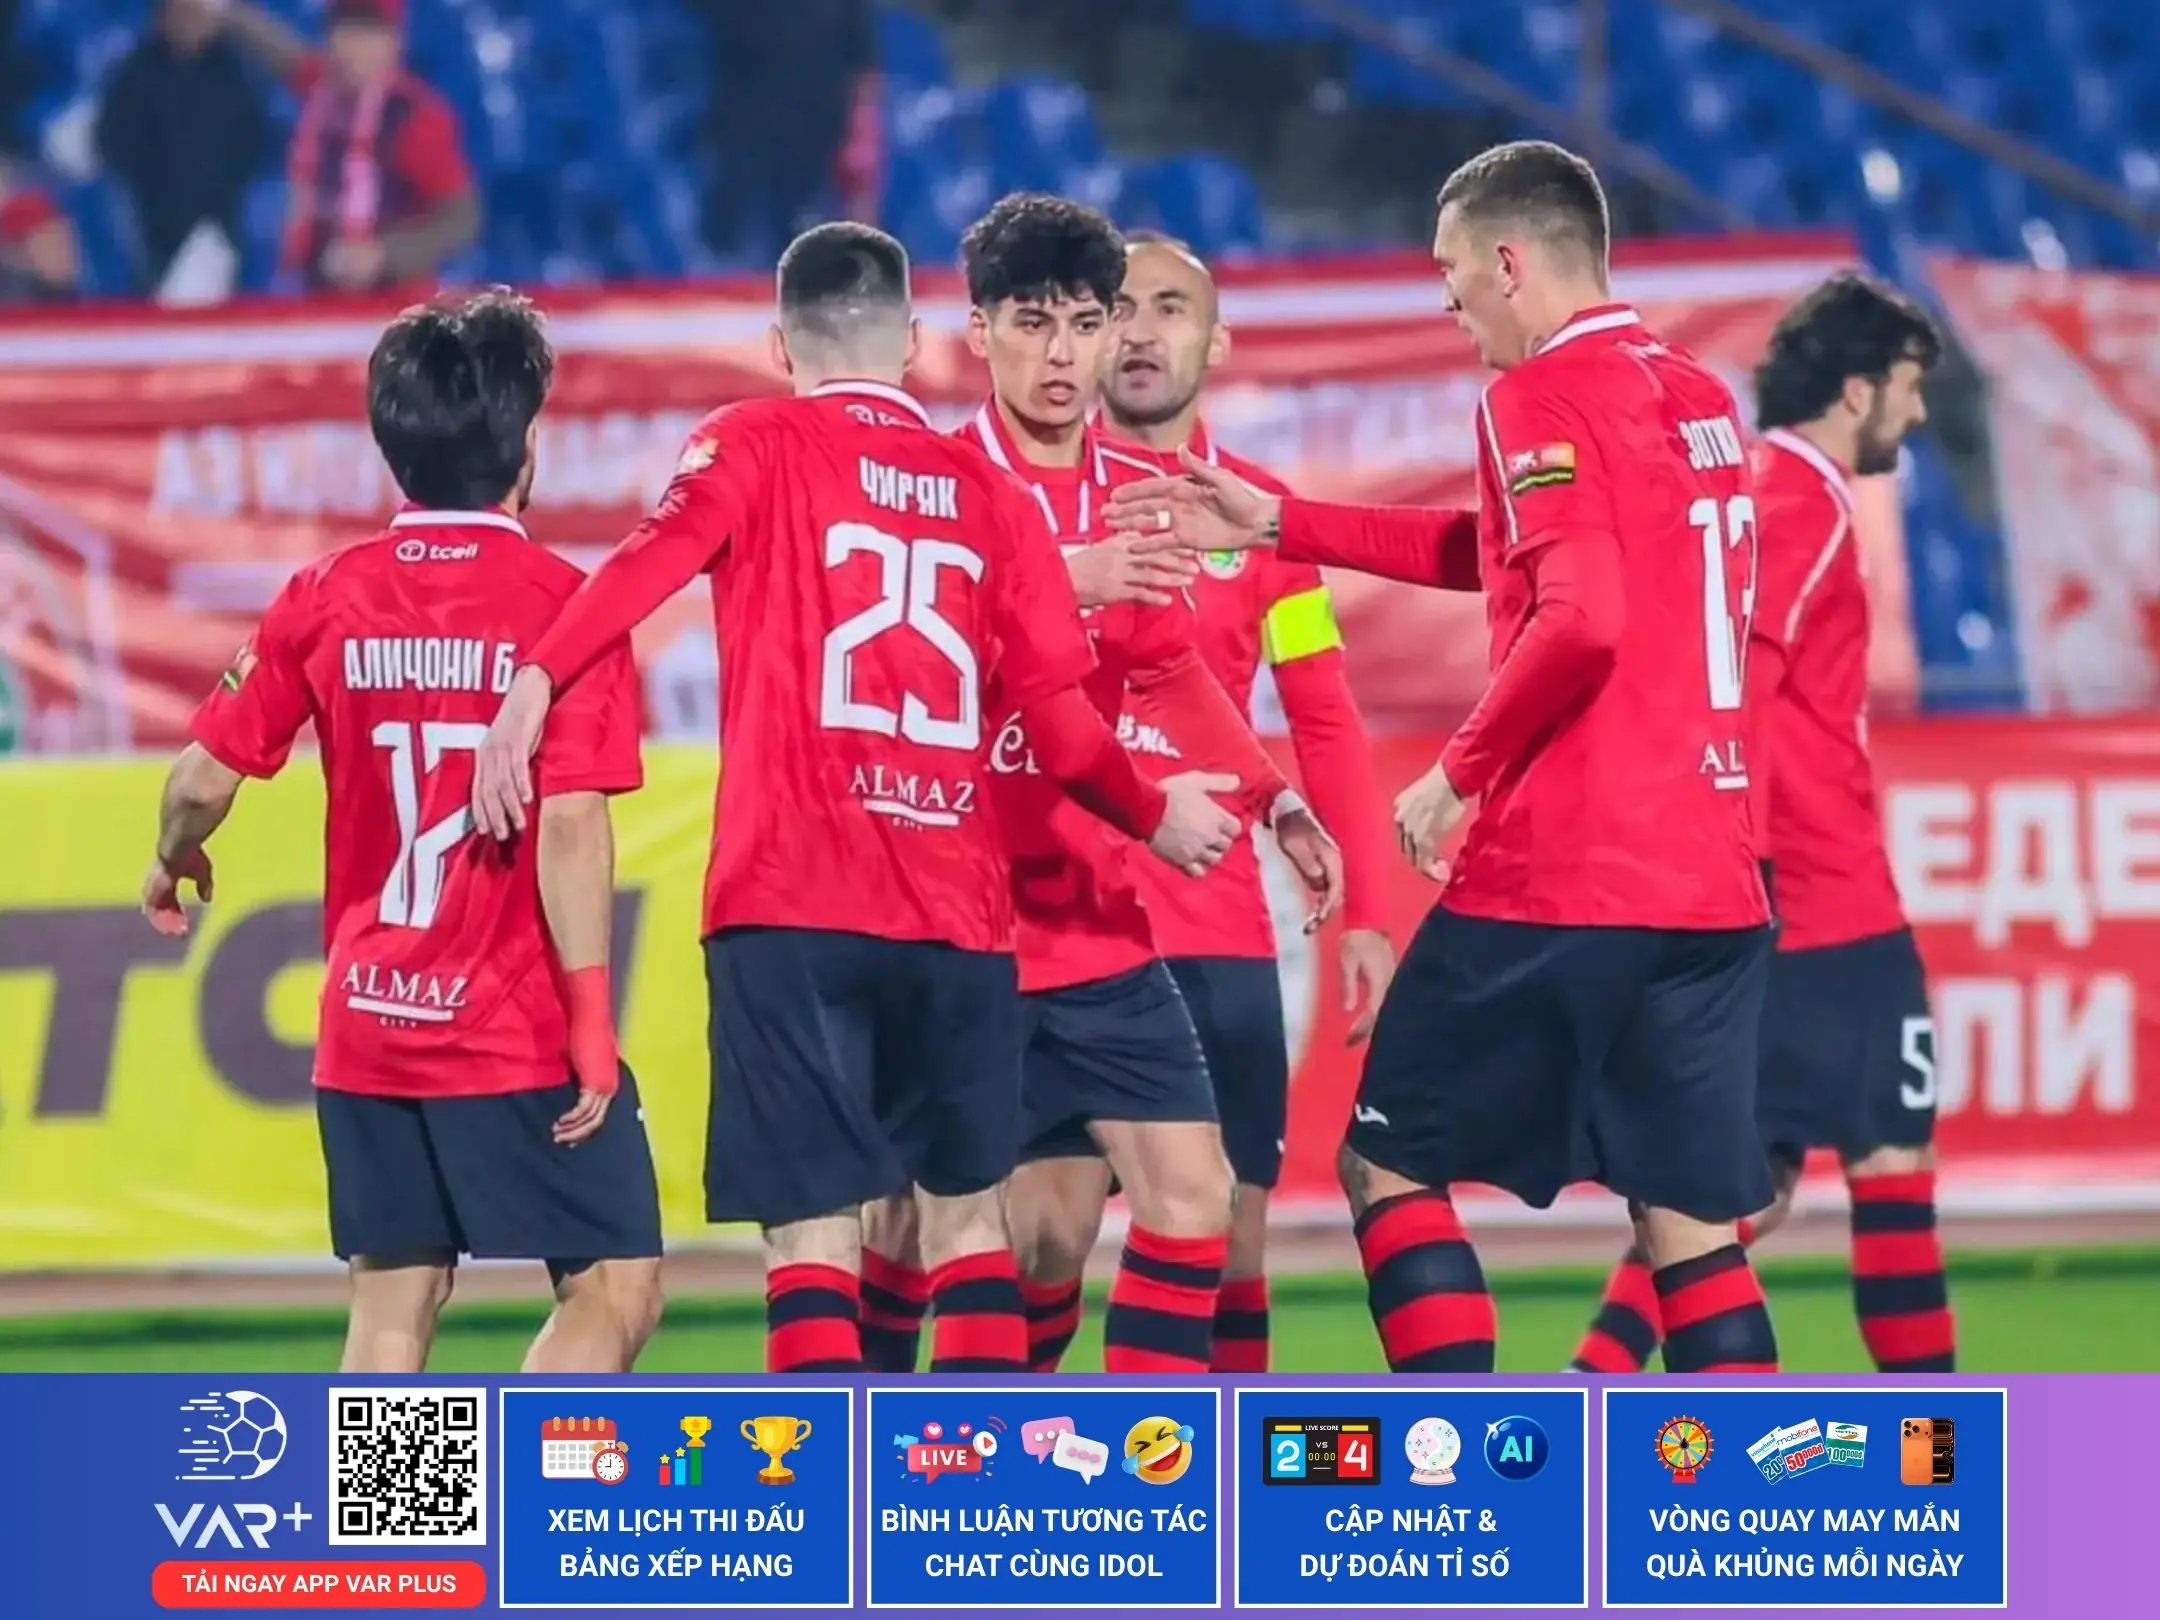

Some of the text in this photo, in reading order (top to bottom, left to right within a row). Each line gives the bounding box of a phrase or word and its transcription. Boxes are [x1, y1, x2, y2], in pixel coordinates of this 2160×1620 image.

[860, 456, 958, 520] ЧИРЯК
[430, 543, 478, 560] tcell
[820, 521, 985, 750] 25
[1698, 739, 1746, 774] AL
[848, 763, 976, 814] ALMAZ
[339, 961, 469, 1008] ALMAZ
